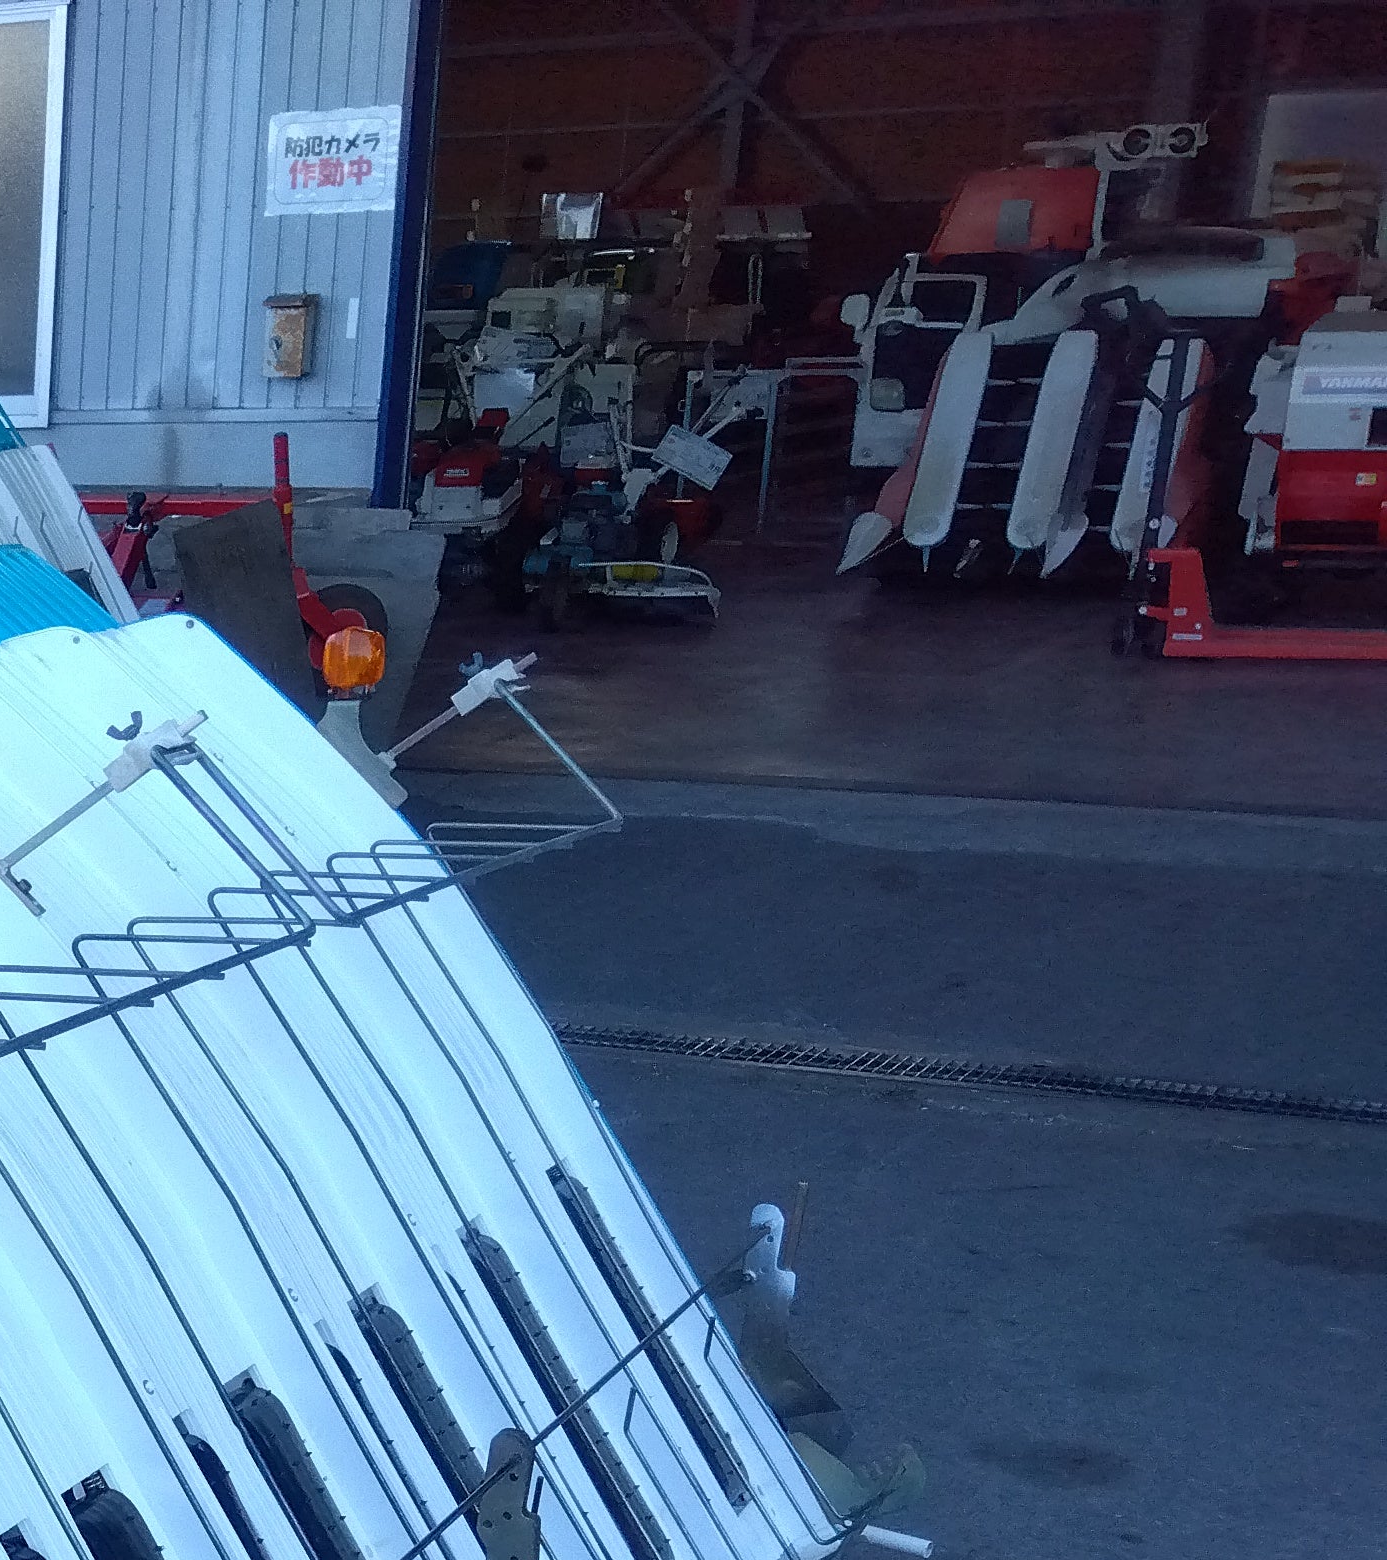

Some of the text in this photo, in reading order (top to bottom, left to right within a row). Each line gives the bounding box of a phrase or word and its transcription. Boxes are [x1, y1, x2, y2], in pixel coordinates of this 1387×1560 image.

[285, 132, 380, 158] 防犯カメラ
[289, 155, 372, 190] 作動中
[1320, 376, 1387, 390] YANMA
